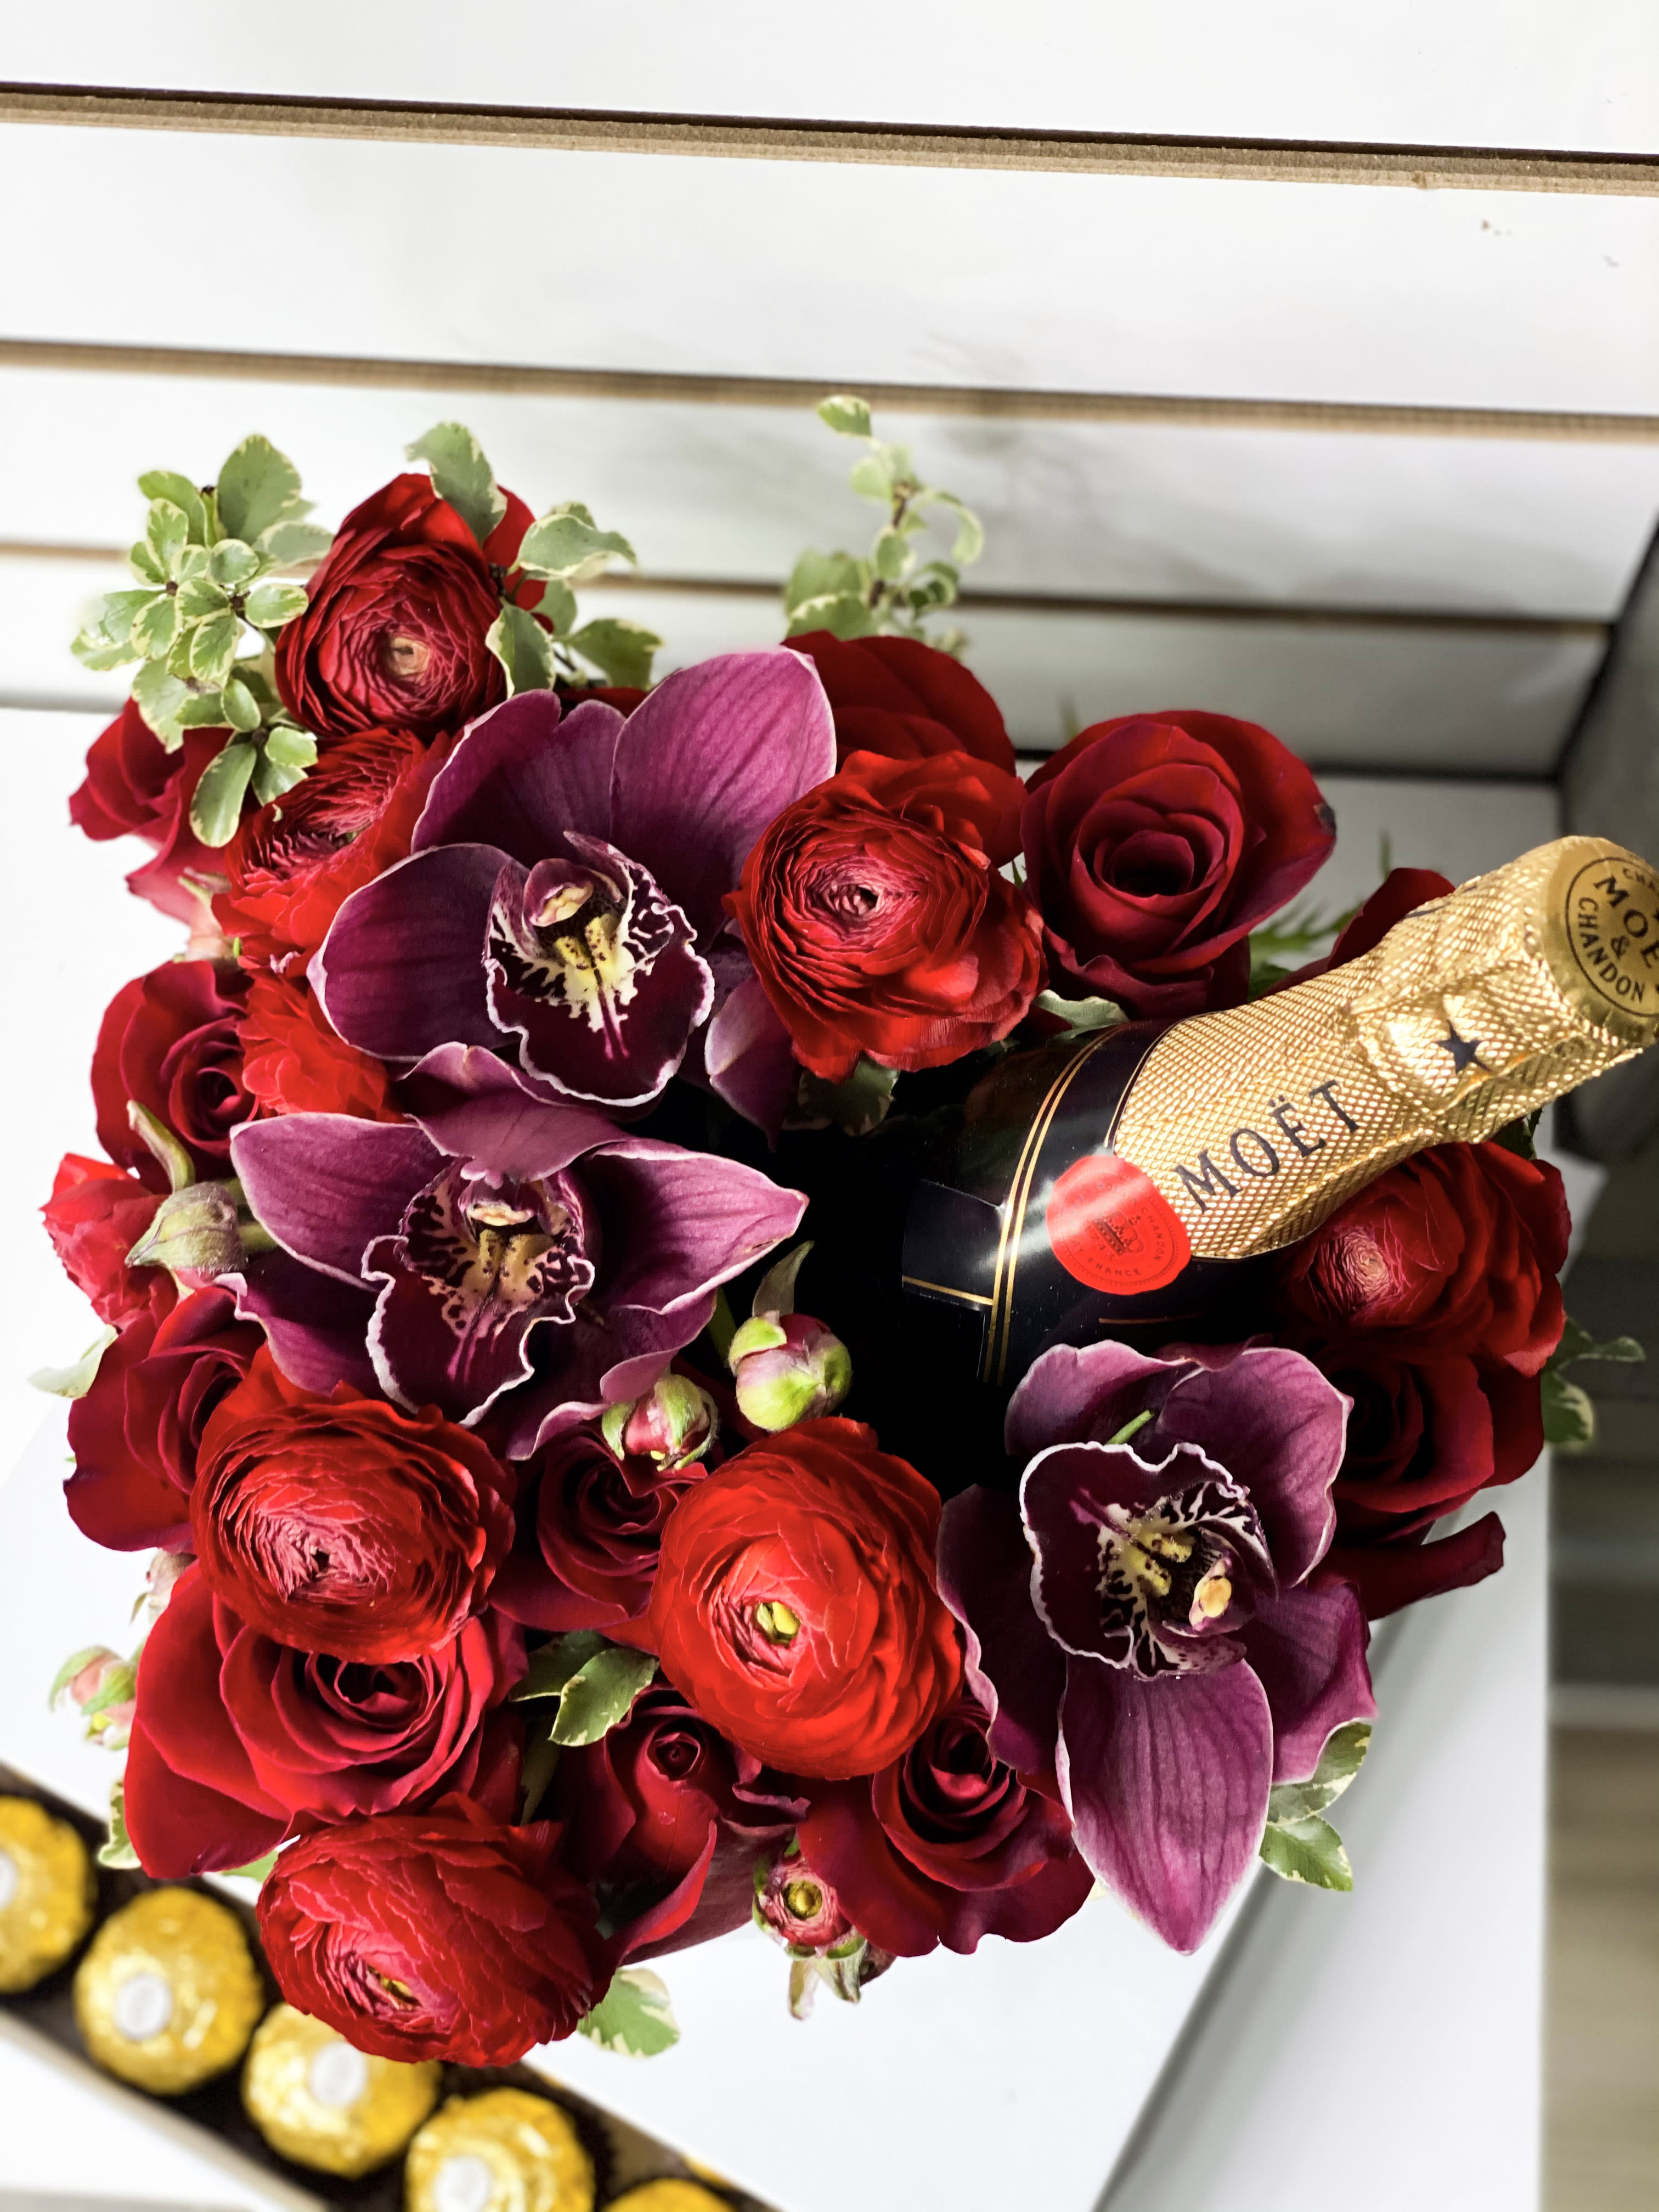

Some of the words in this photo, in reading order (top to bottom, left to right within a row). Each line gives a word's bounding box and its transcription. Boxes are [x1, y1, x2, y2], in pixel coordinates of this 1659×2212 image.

[1578, 897, 1645, 1003] CHANDON
[1610, 935, 1630, 959] &
[1173, 1079, 1360, 1214] MOËT
[1141, 1206, 1165, 1260] CHANDON
[1087, 1257, 1142, 1277] FRANCE
